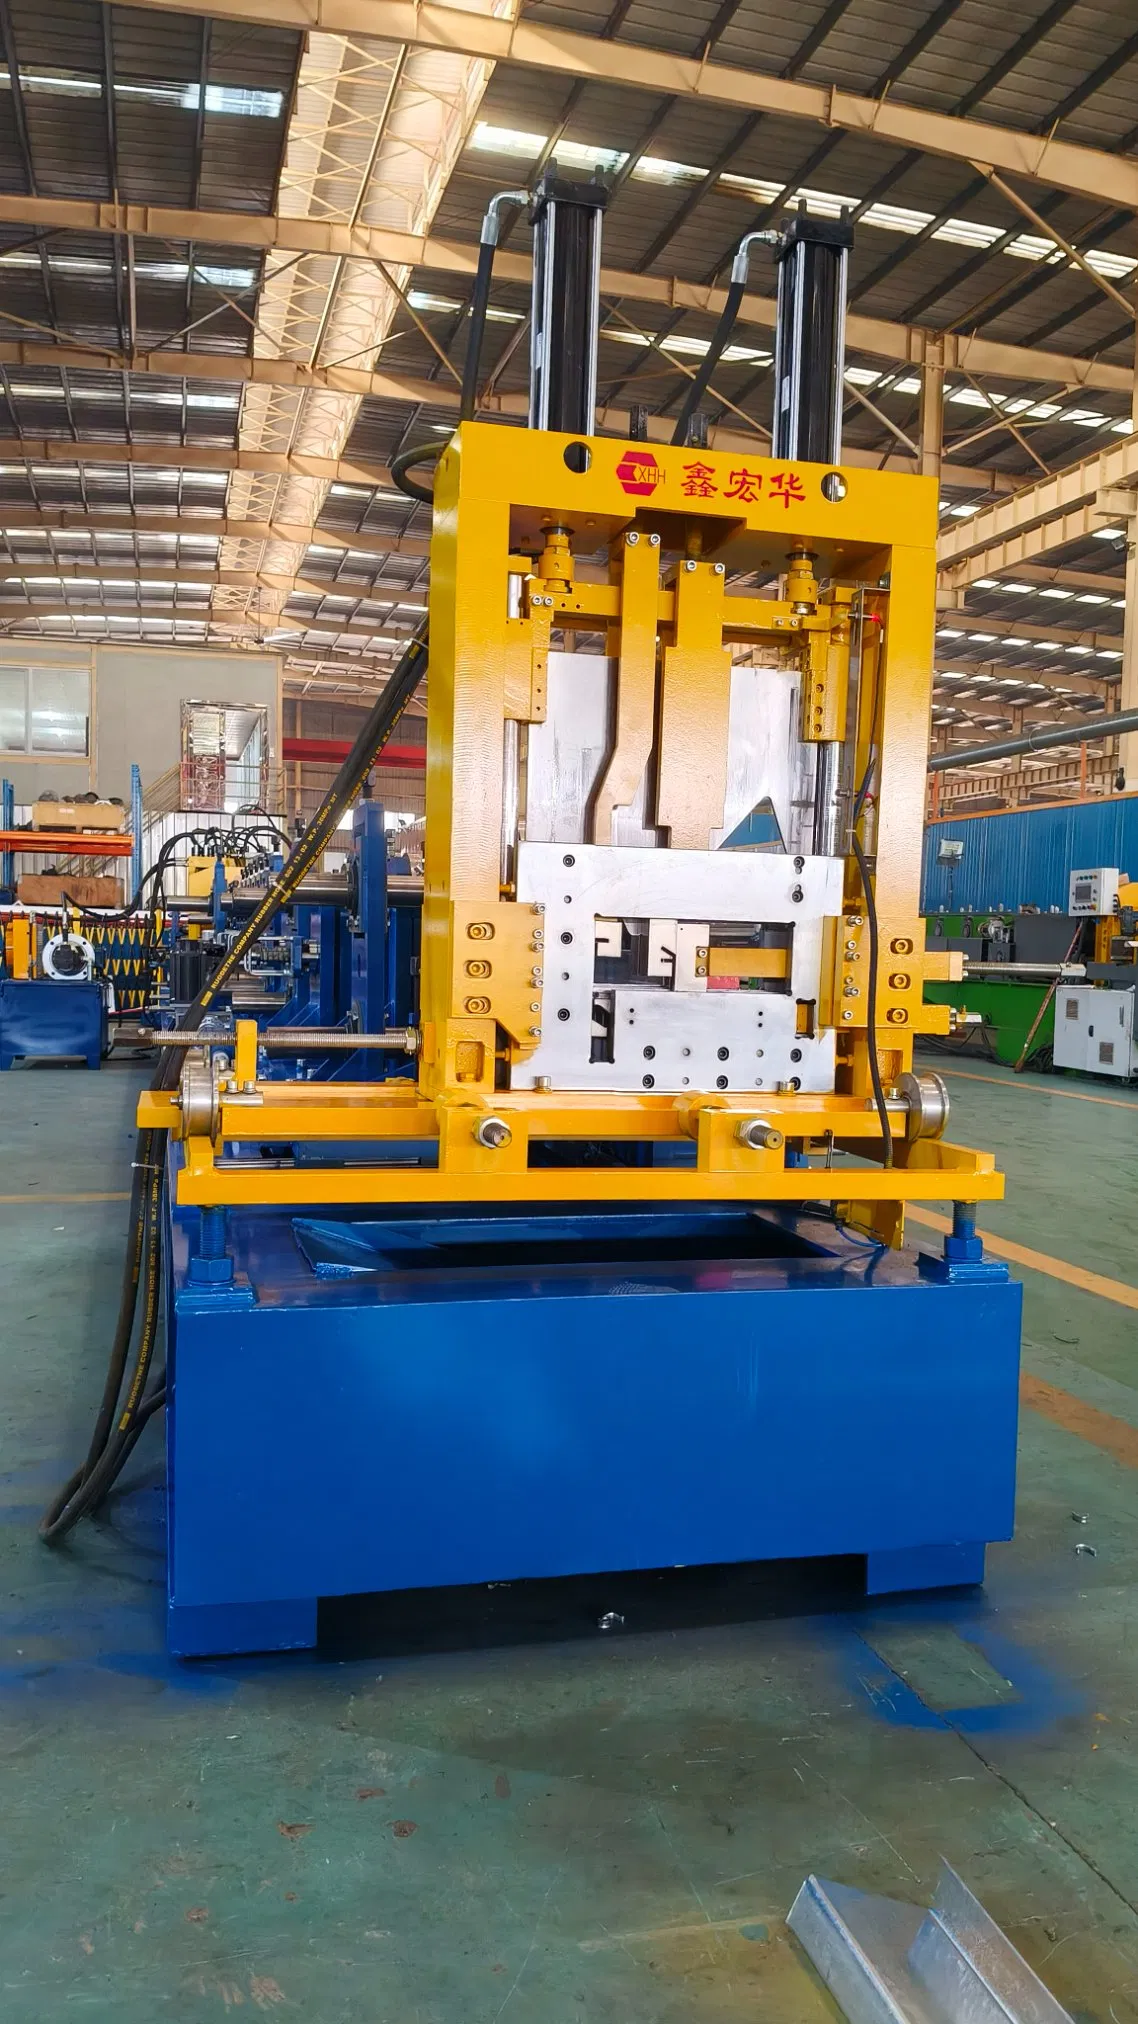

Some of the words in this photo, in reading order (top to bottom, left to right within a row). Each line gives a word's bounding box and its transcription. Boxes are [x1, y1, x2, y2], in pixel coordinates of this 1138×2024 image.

[638, 467, 666, 485] XHH
[680, 461, 806, 509] 鑫宏华
[234, 923, 256, 954] COMPANY
[254, 898, 273, 923] RUBBER
